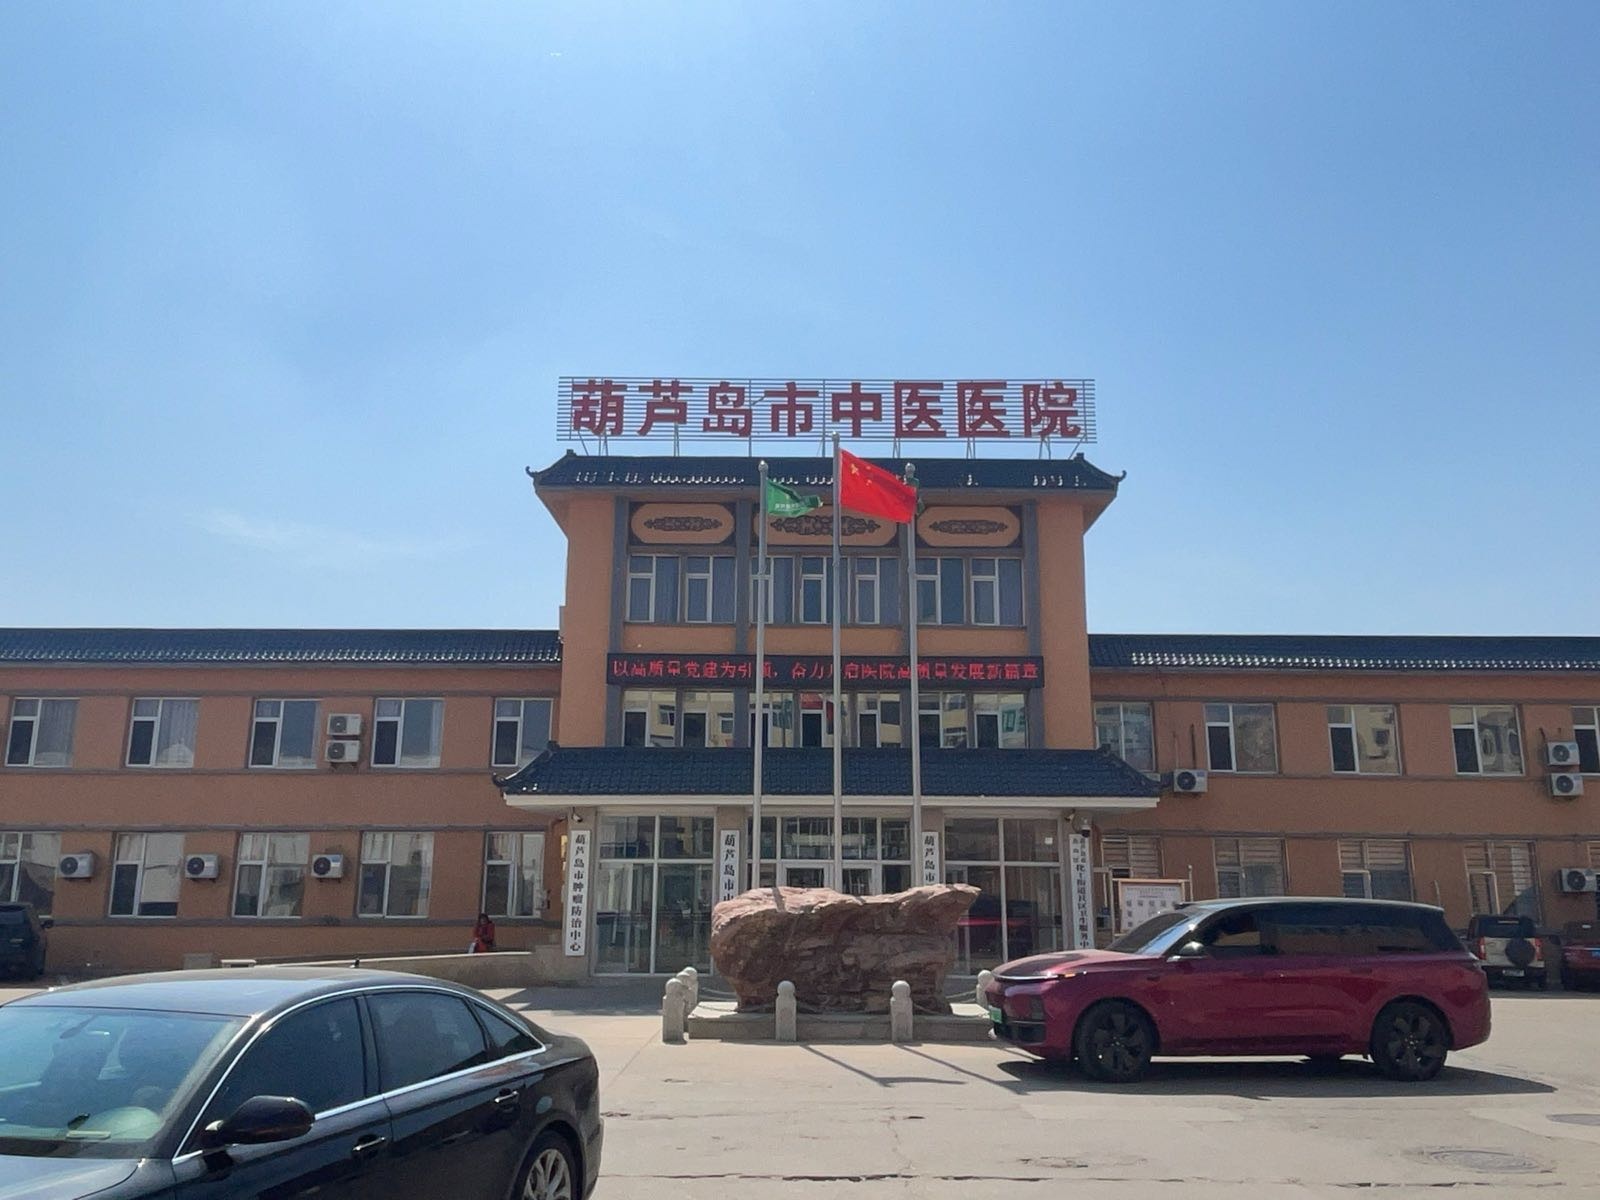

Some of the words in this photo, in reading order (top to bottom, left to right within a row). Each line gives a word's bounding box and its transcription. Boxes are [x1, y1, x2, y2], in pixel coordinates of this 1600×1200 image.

[571, 379, 1081, 438] 葫芦岛市中医医院
[924, 835, 936, 882] 葫芦岛市
[569, 834, 586, 952] 葫芦岛市肿瘤防治中心
